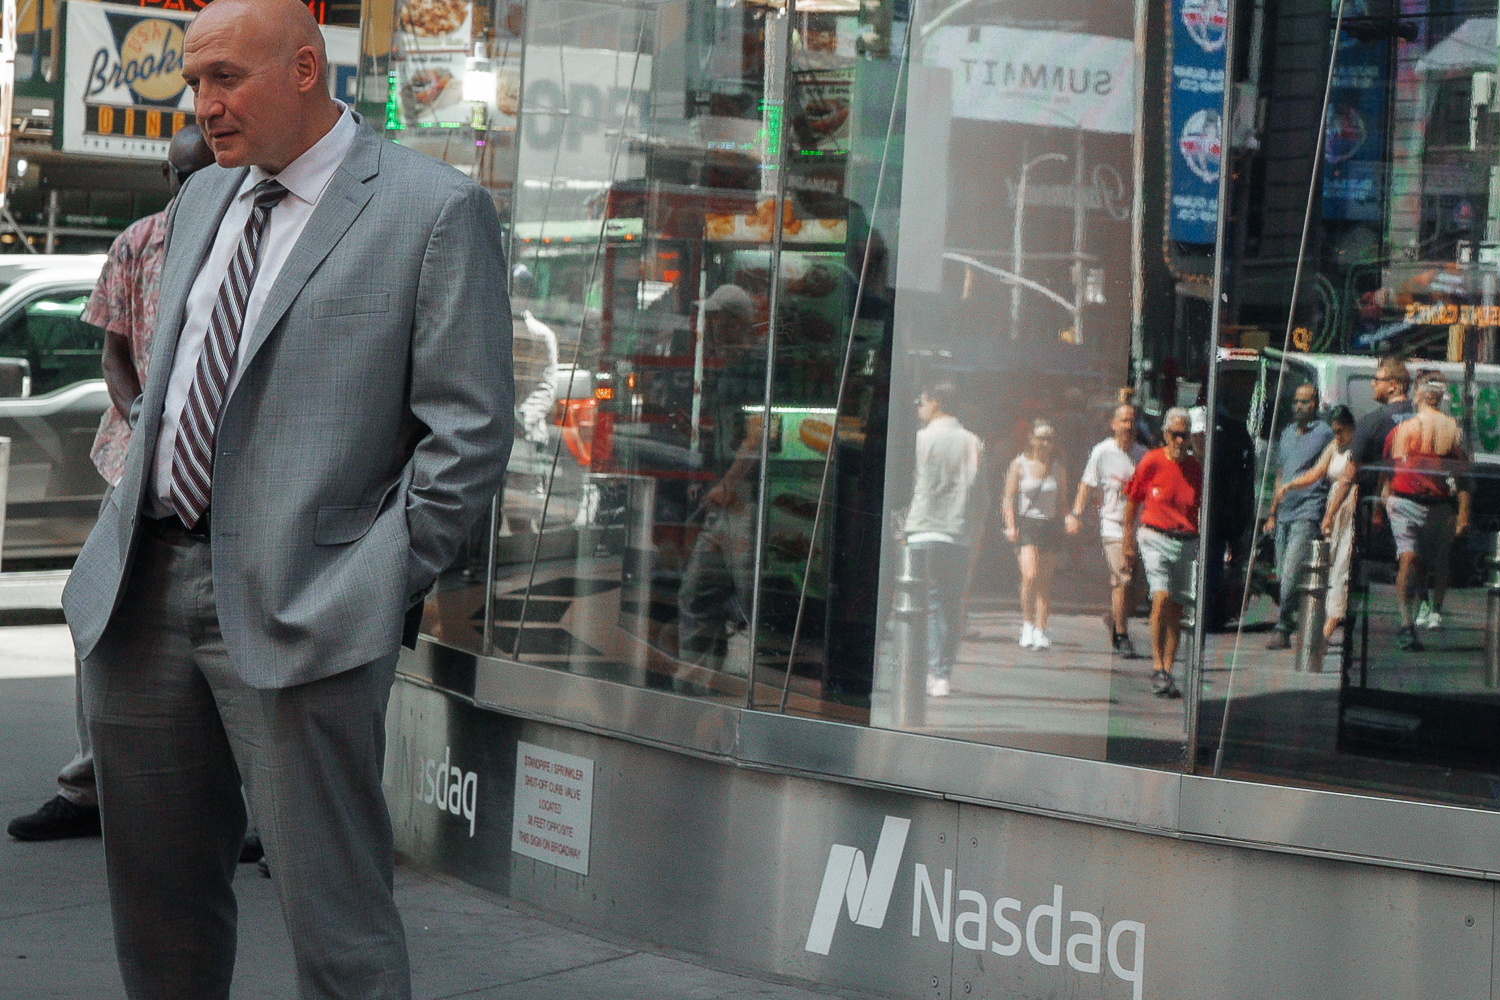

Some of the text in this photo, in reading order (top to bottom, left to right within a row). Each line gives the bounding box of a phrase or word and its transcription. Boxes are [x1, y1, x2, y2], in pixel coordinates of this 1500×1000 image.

[83, 28, 184, 99] Brook
[97, 106, 187, 138] DINE
[412, 745, 478, 839] asdaq
[910, 862, 1147, 1000] Nasdaq
